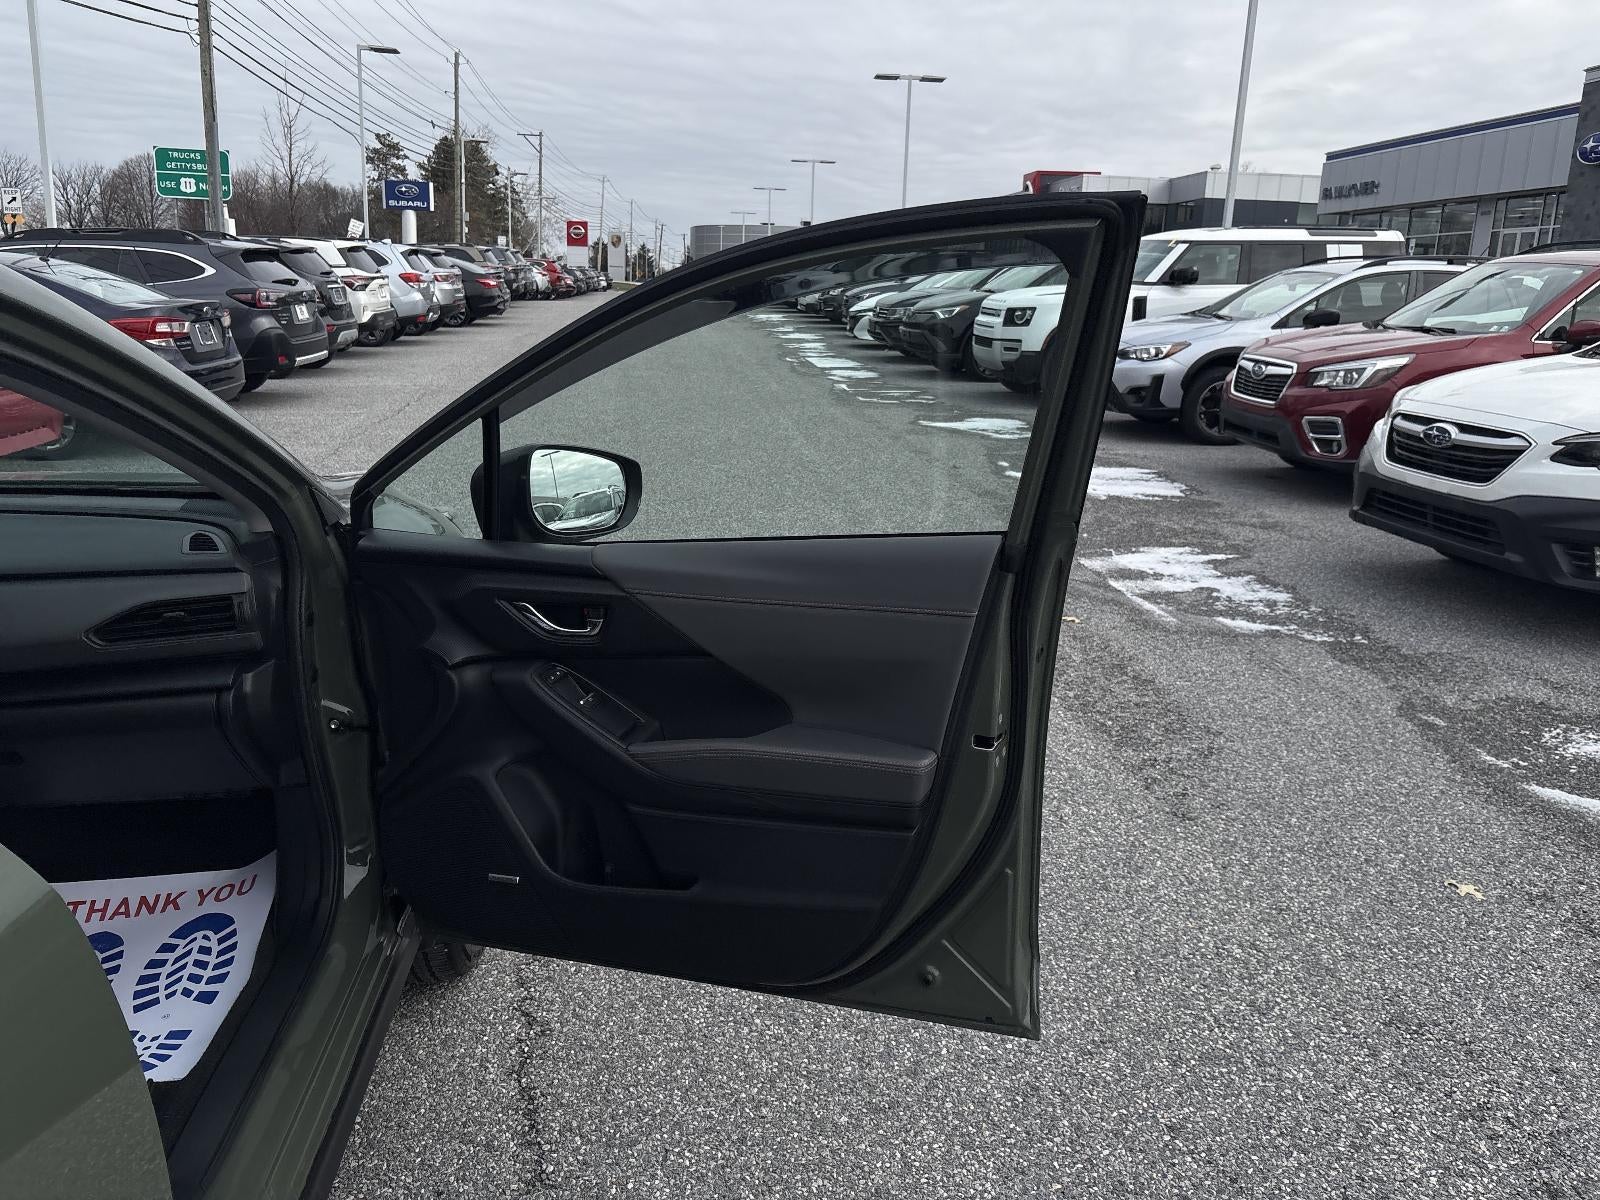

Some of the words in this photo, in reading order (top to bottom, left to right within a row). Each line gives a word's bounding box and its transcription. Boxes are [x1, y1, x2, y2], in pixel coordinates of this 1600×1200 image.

[168, 151, 201, 160] TRUCKS
[165, 161, 208, 171] GETTYSBU
[160, 180, 177, 188] USE
[184, 180, 192, 190] 11
[388, 199, 427, 208] SUBARU
[66, 890, 188, 924] THANK
[196, 873, 258, 907] YOU
